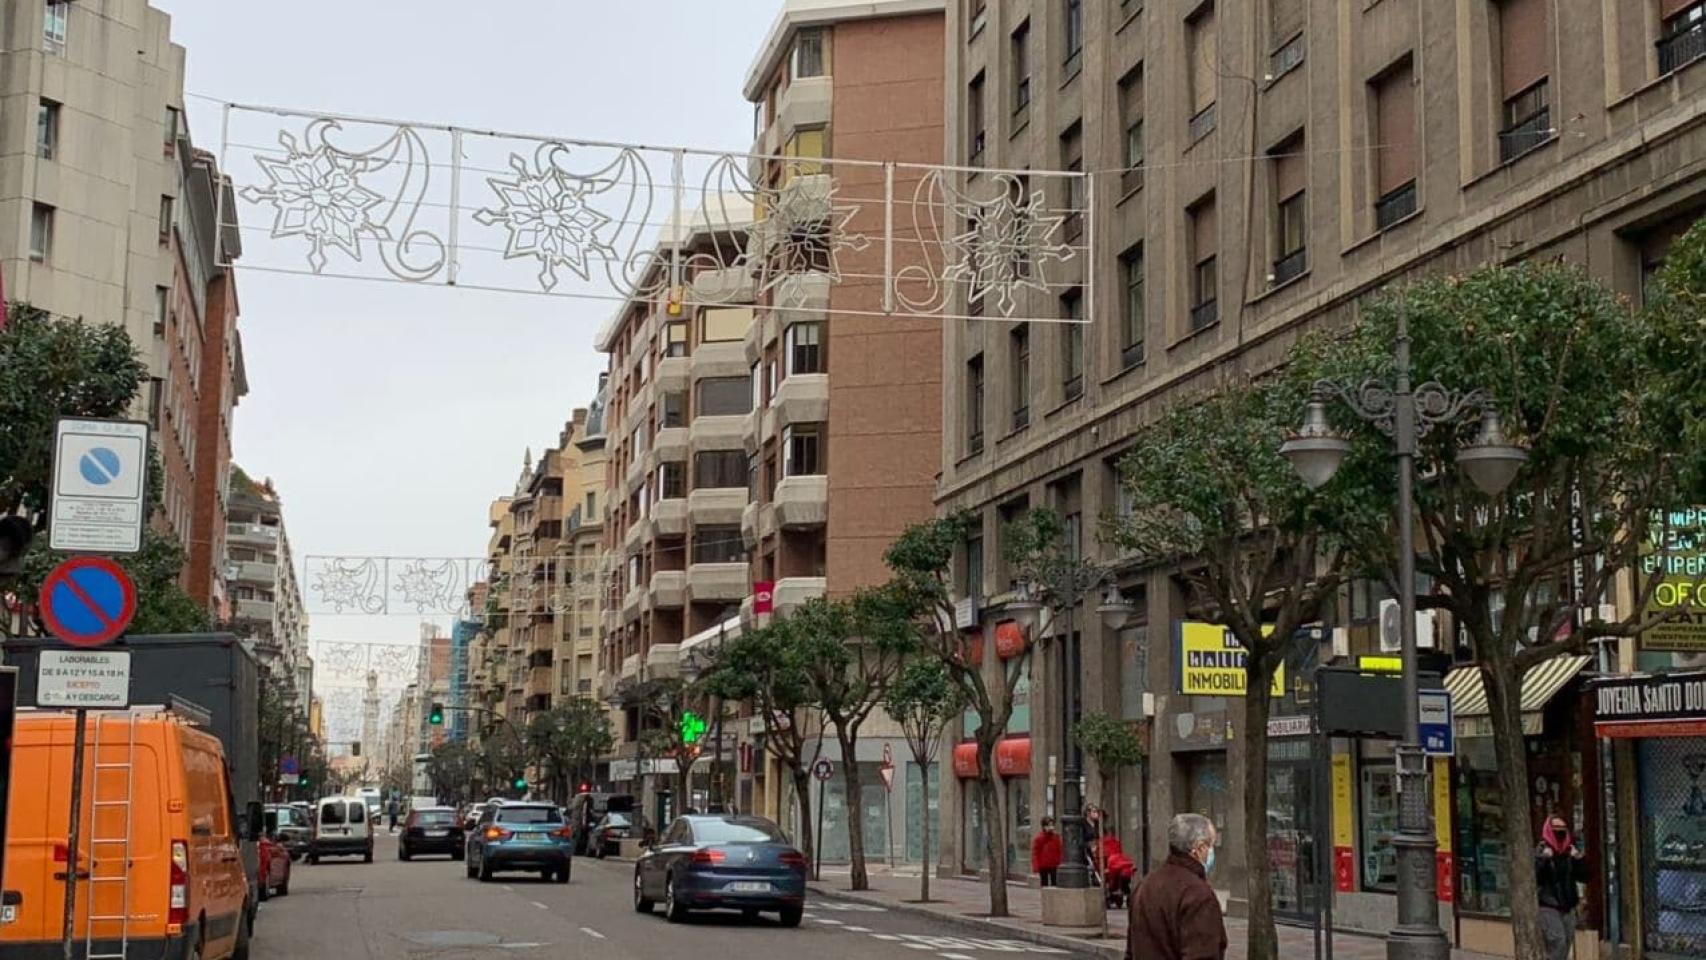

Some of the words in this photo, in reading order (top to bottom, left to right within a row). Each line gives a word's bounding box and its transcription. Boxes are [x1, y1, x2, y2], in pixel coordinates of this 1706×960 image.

[59, 655, 111, 664] LABORABLES
[42, 668, 53, 676] DE
[1187, 672, 1280, 691] INMOBILIA
[1595, 685, 1641, 715] JOYERIA
[1643, 683, 1682, 714] SANTO
